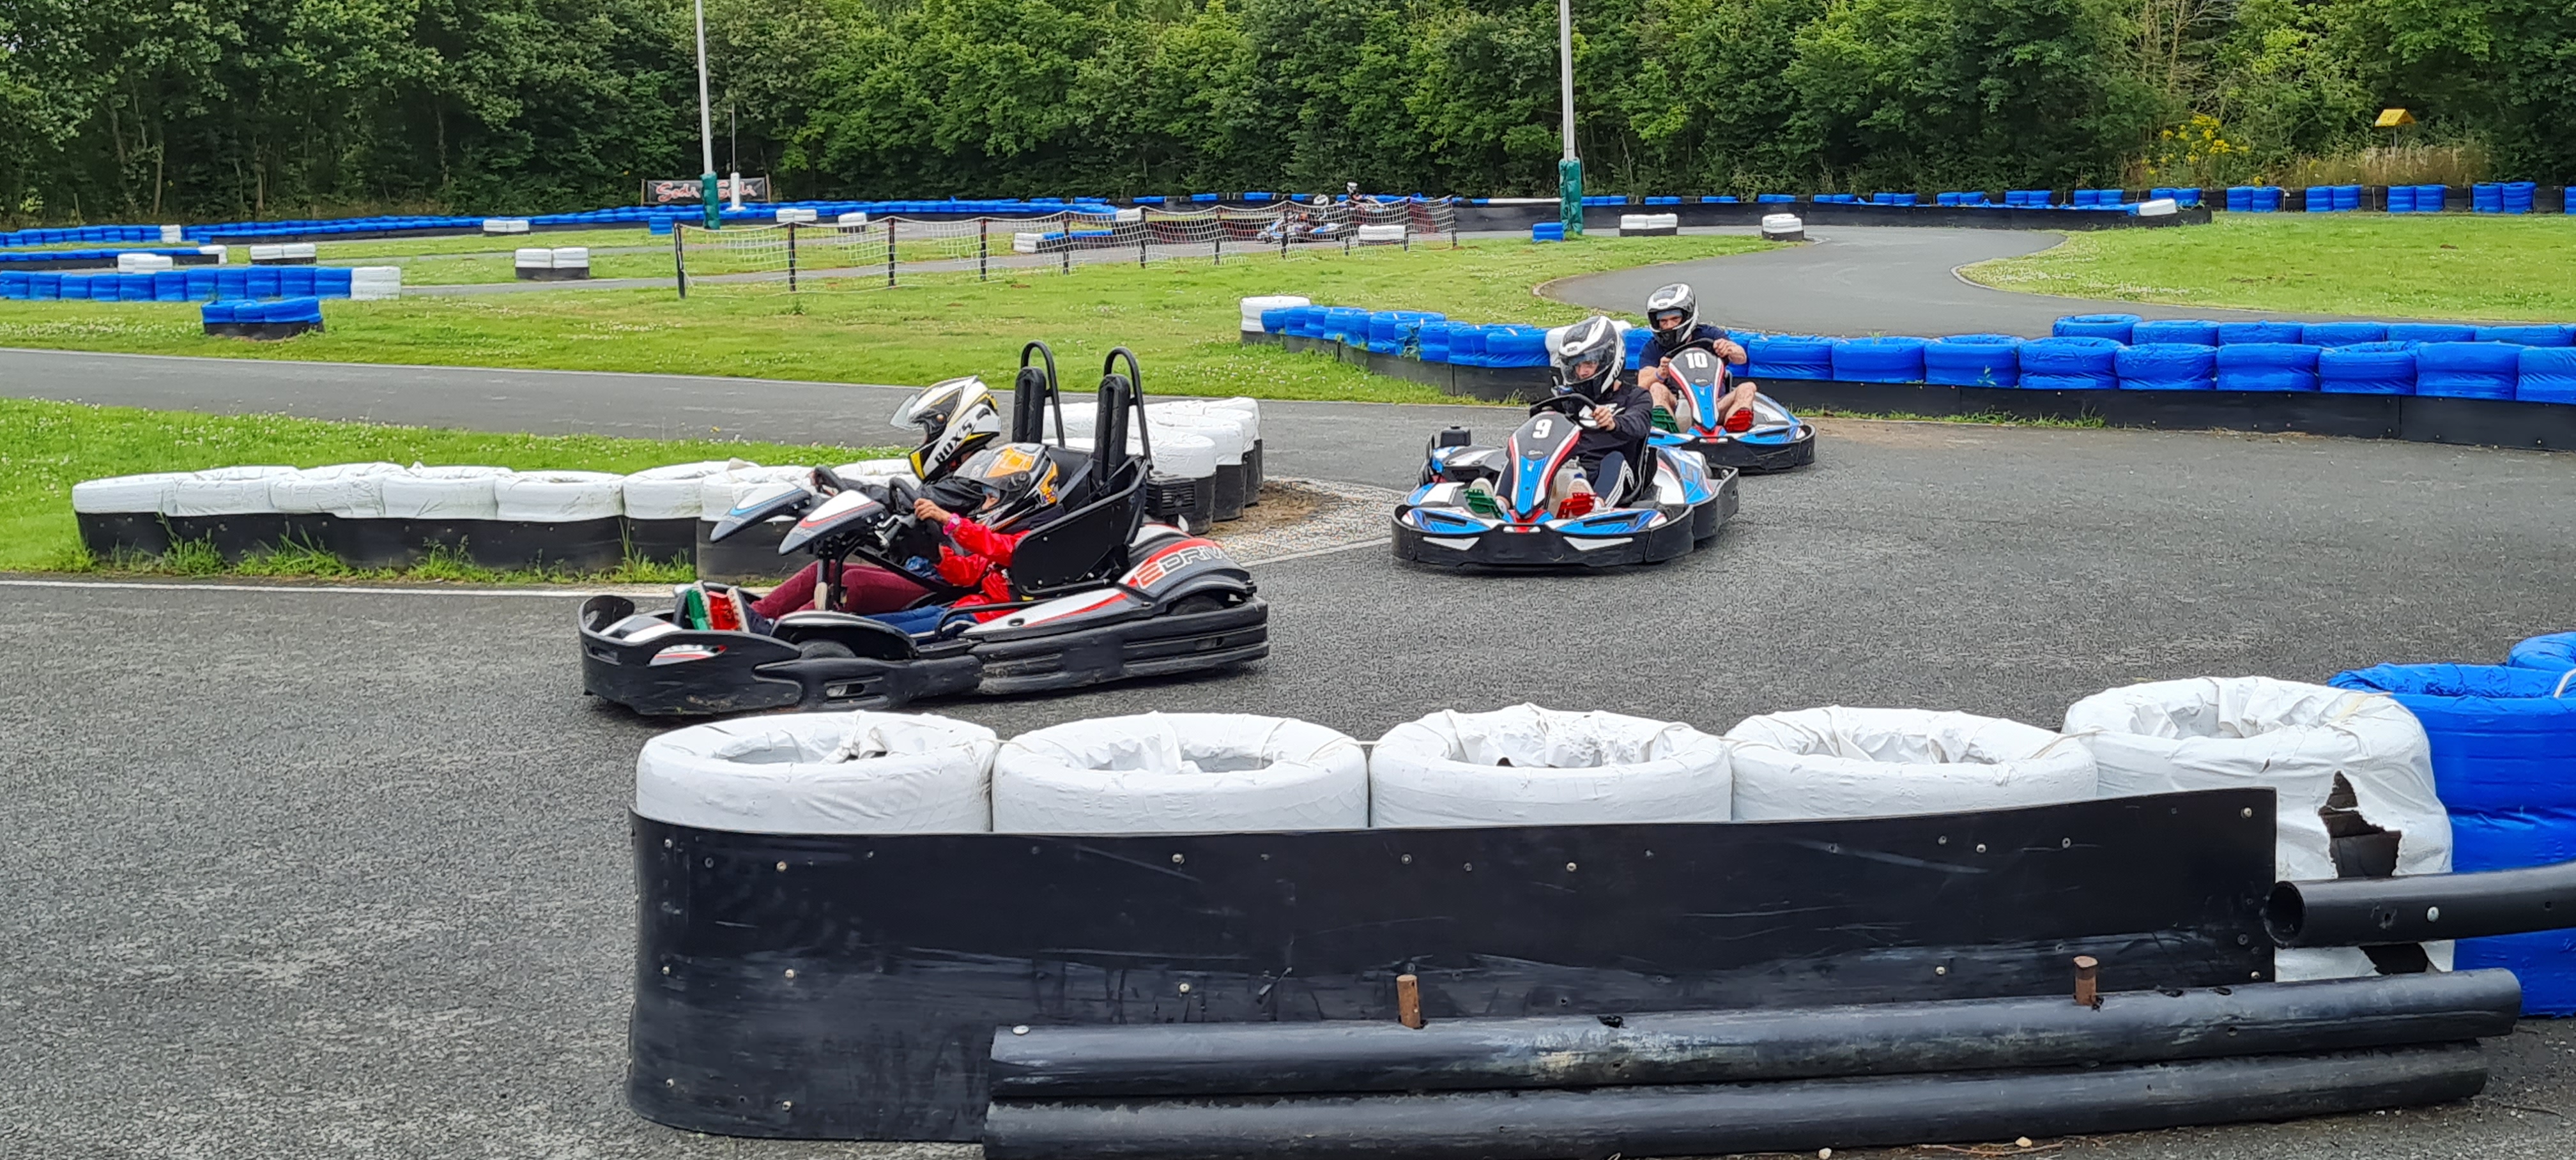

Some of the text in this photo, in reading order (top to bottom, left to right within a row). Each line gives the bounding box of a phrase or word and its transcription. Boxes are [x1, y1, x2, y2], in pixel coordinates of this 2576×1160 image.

[656, 181, 701, 202] Sodi
[1685, 352, 1708, 369] 10
[1532, 418, 1552, 439] 9
